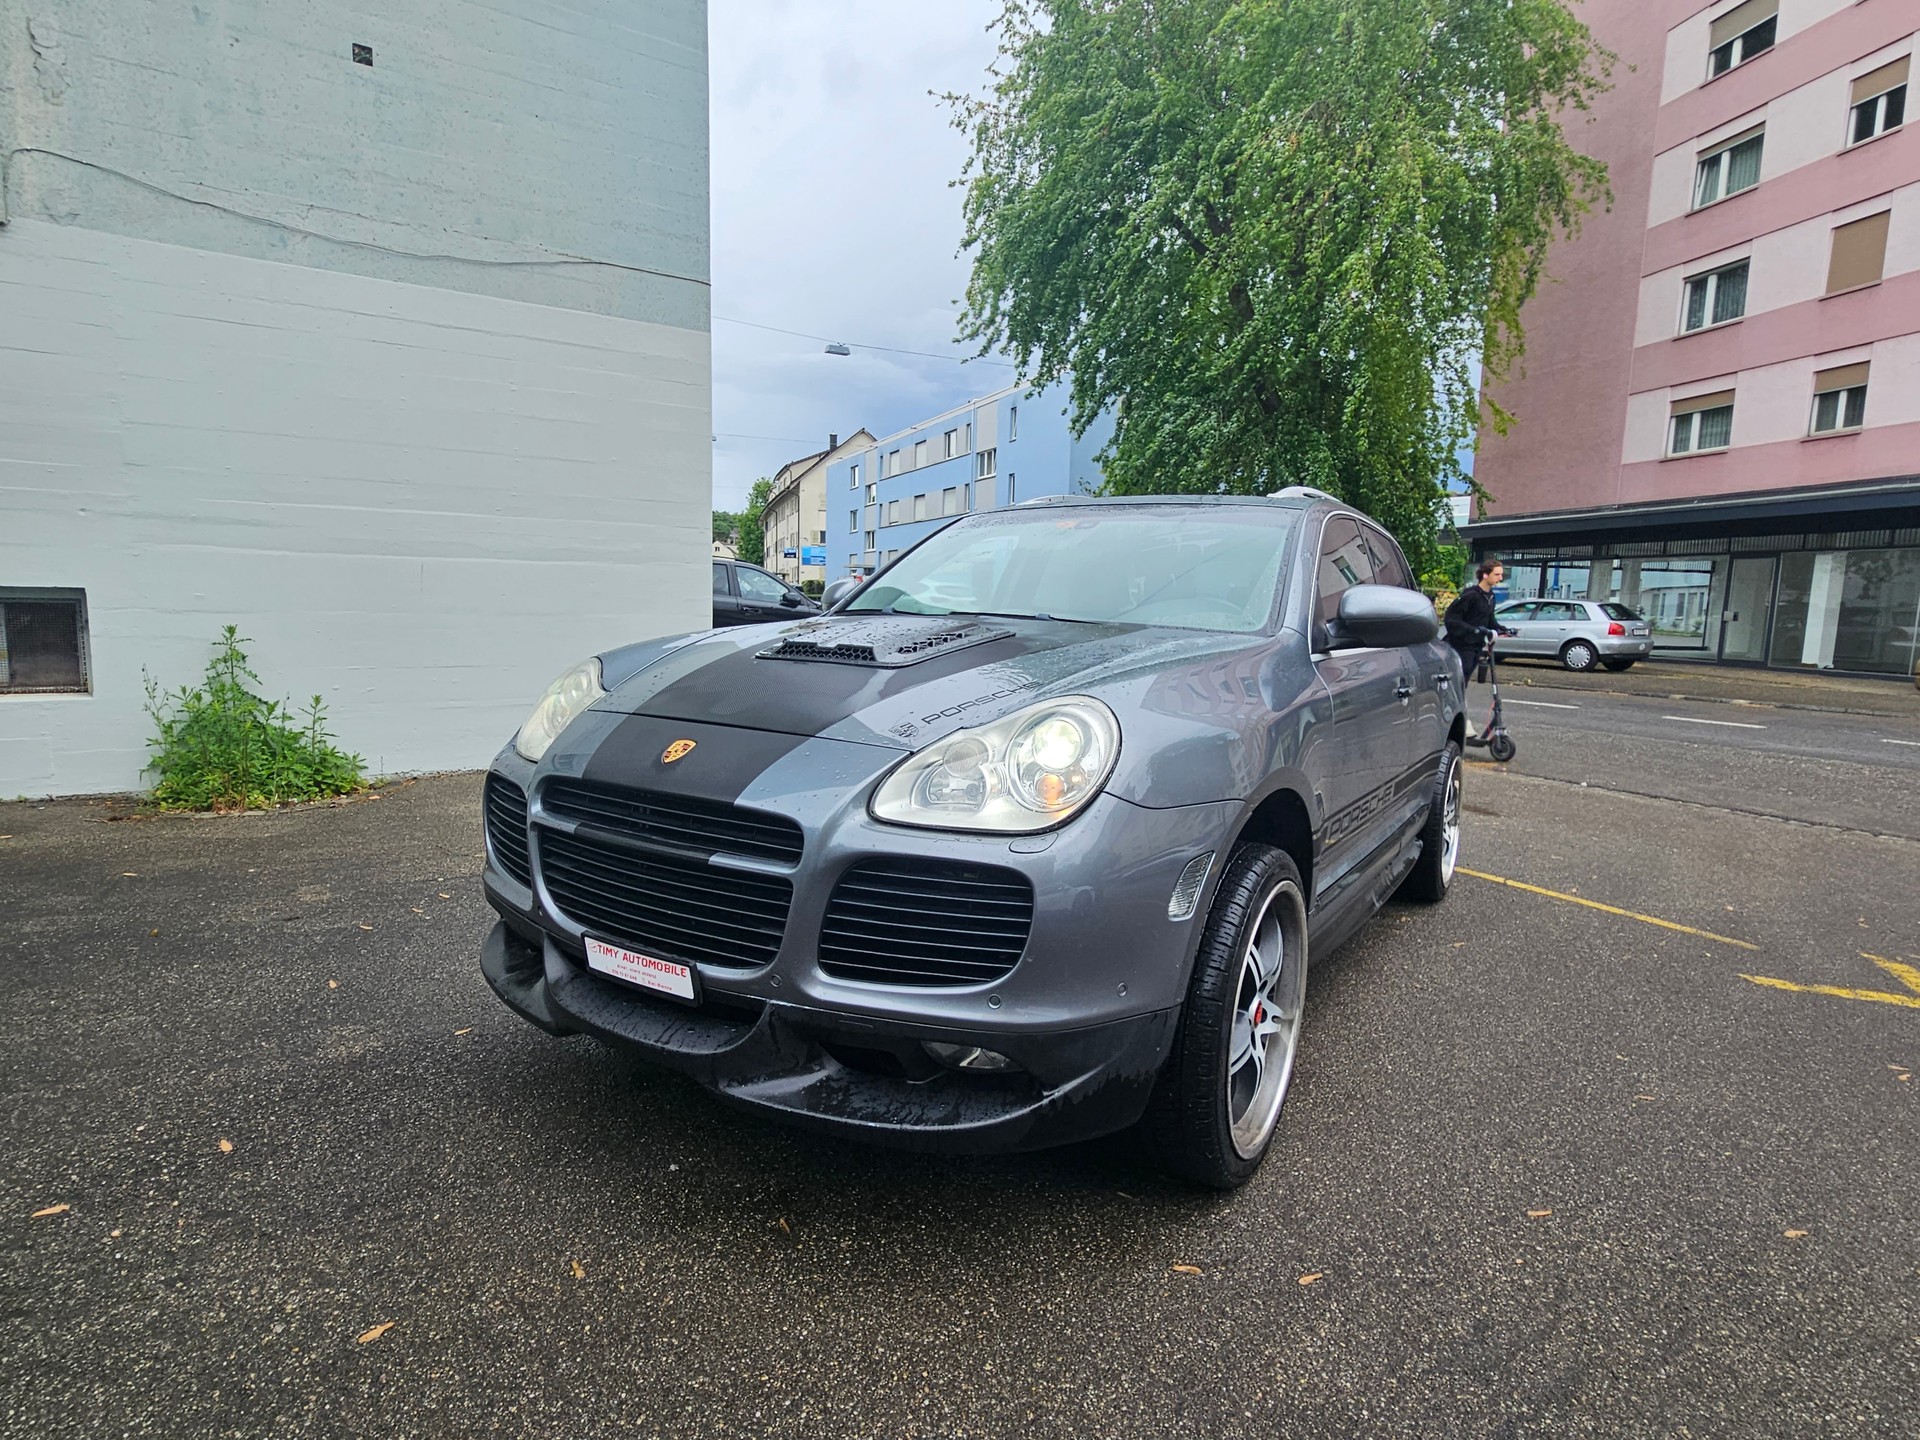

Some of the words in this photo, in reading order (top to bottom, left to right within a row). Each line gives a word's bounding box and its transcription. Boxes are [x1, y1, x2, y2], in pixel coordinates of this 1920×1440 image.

[921, 680, 1043, 725] PORSCHE
[597, 944, 619, 958] TIMY
[622, 953, 687, 977] AUTOMOBILE
